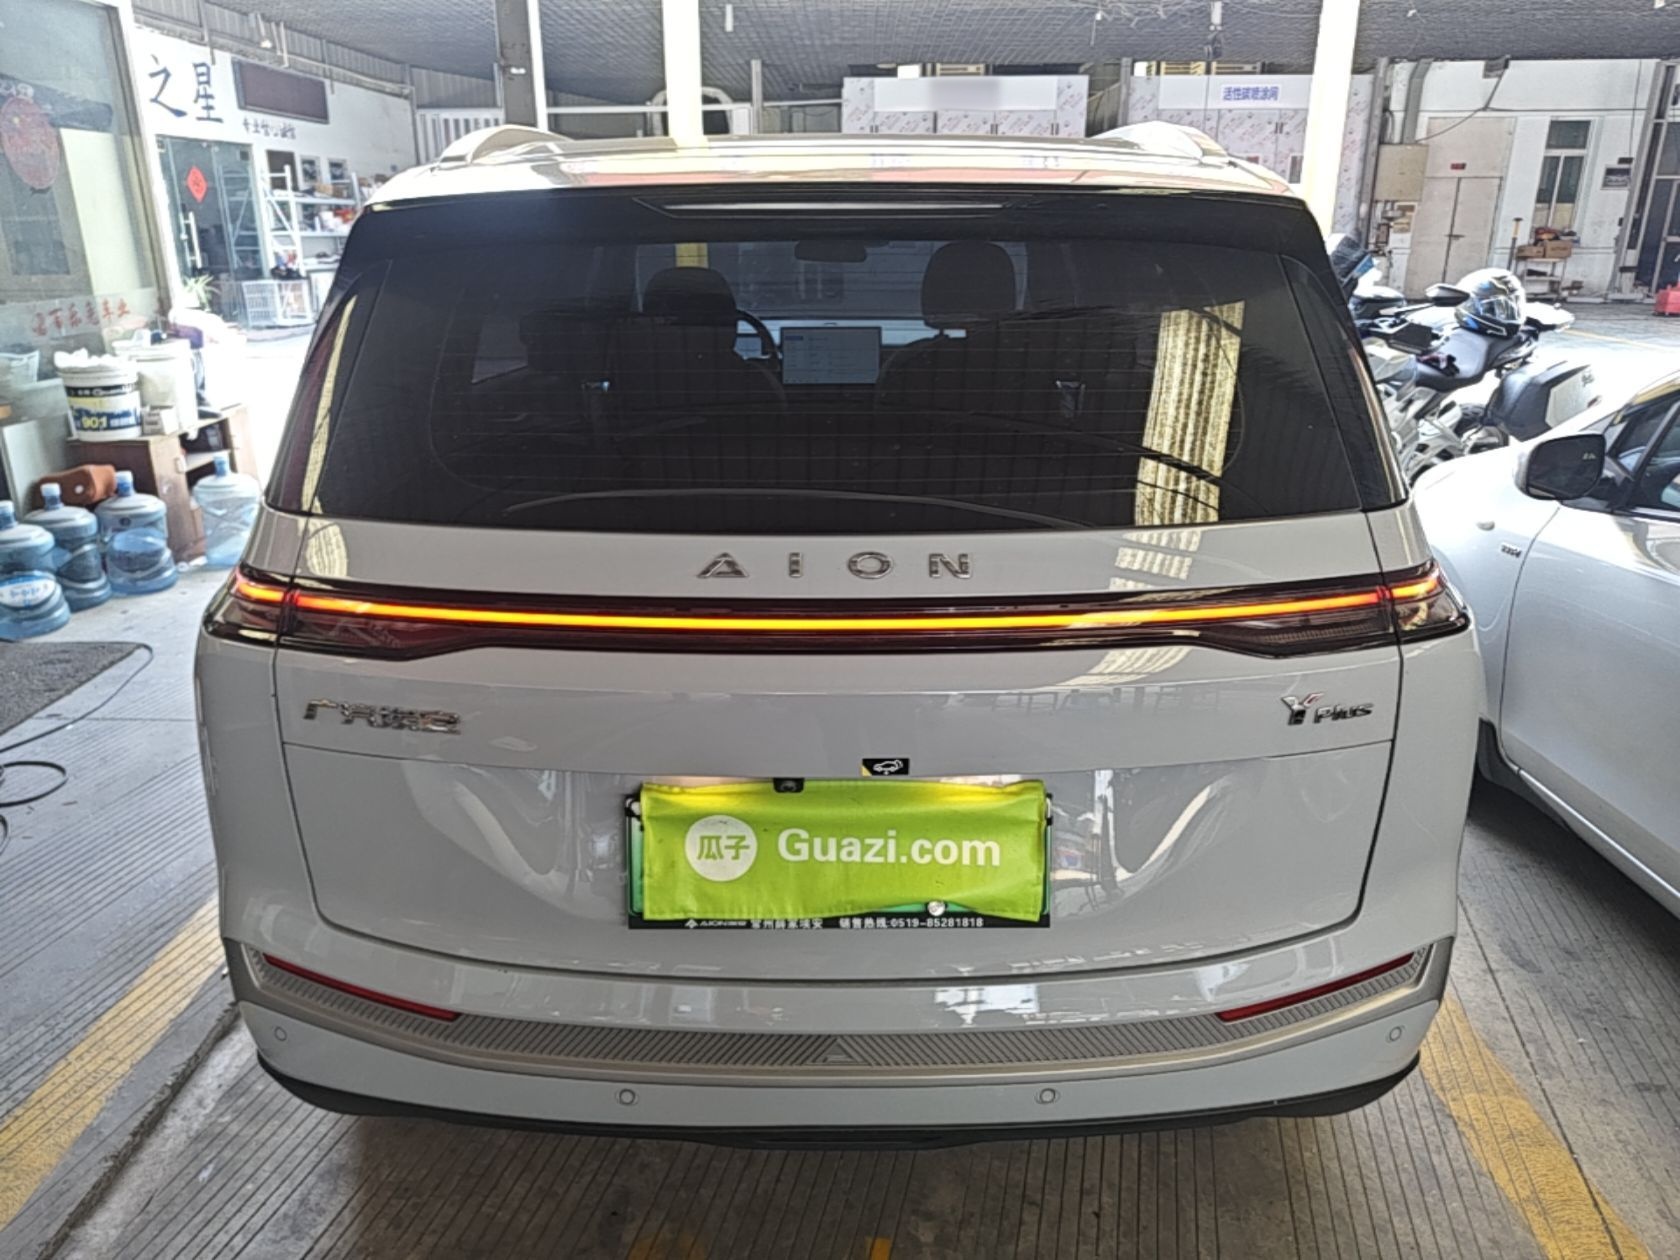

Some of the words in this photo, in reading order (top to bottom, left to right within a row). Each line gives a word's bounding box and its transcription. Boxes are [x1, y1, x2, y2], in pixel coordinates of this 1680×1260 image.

[148, 54, 224, 124] 之星
[696, 551, 974, 580] AION
[1313, 703, 1374, 725] Plus
[696, 833, 751, 861] 瓜子
[777, 827, 1002, 867] Guazi.com
